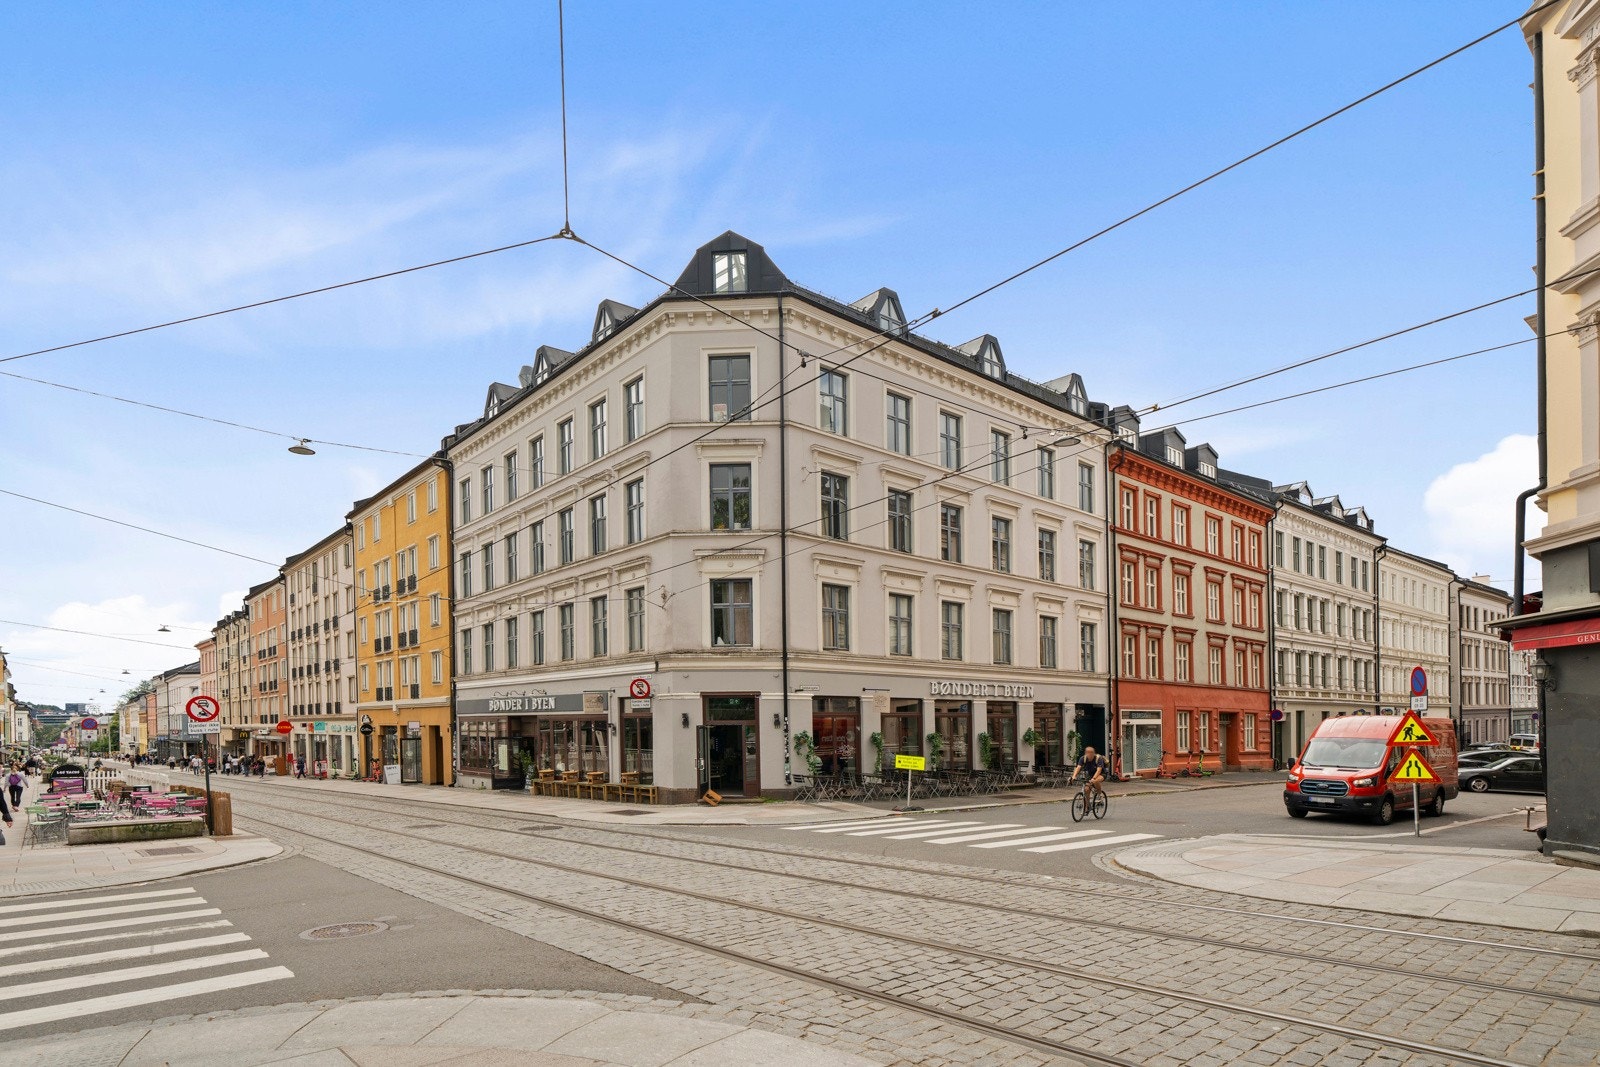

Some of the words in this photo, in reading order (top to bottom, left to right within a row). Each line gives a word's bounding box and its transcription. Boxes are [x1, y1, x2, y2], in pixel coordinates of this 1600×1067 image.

[930, 681, 988, 696] BØNDER
[993, 684, 999, 697] I
[1004, 685, 1034, 698] BYEN
[488, 699, 522, 712] BØNDER
[525, 698, 529, 710] I
[531, 697, 556, 710] BYEN
